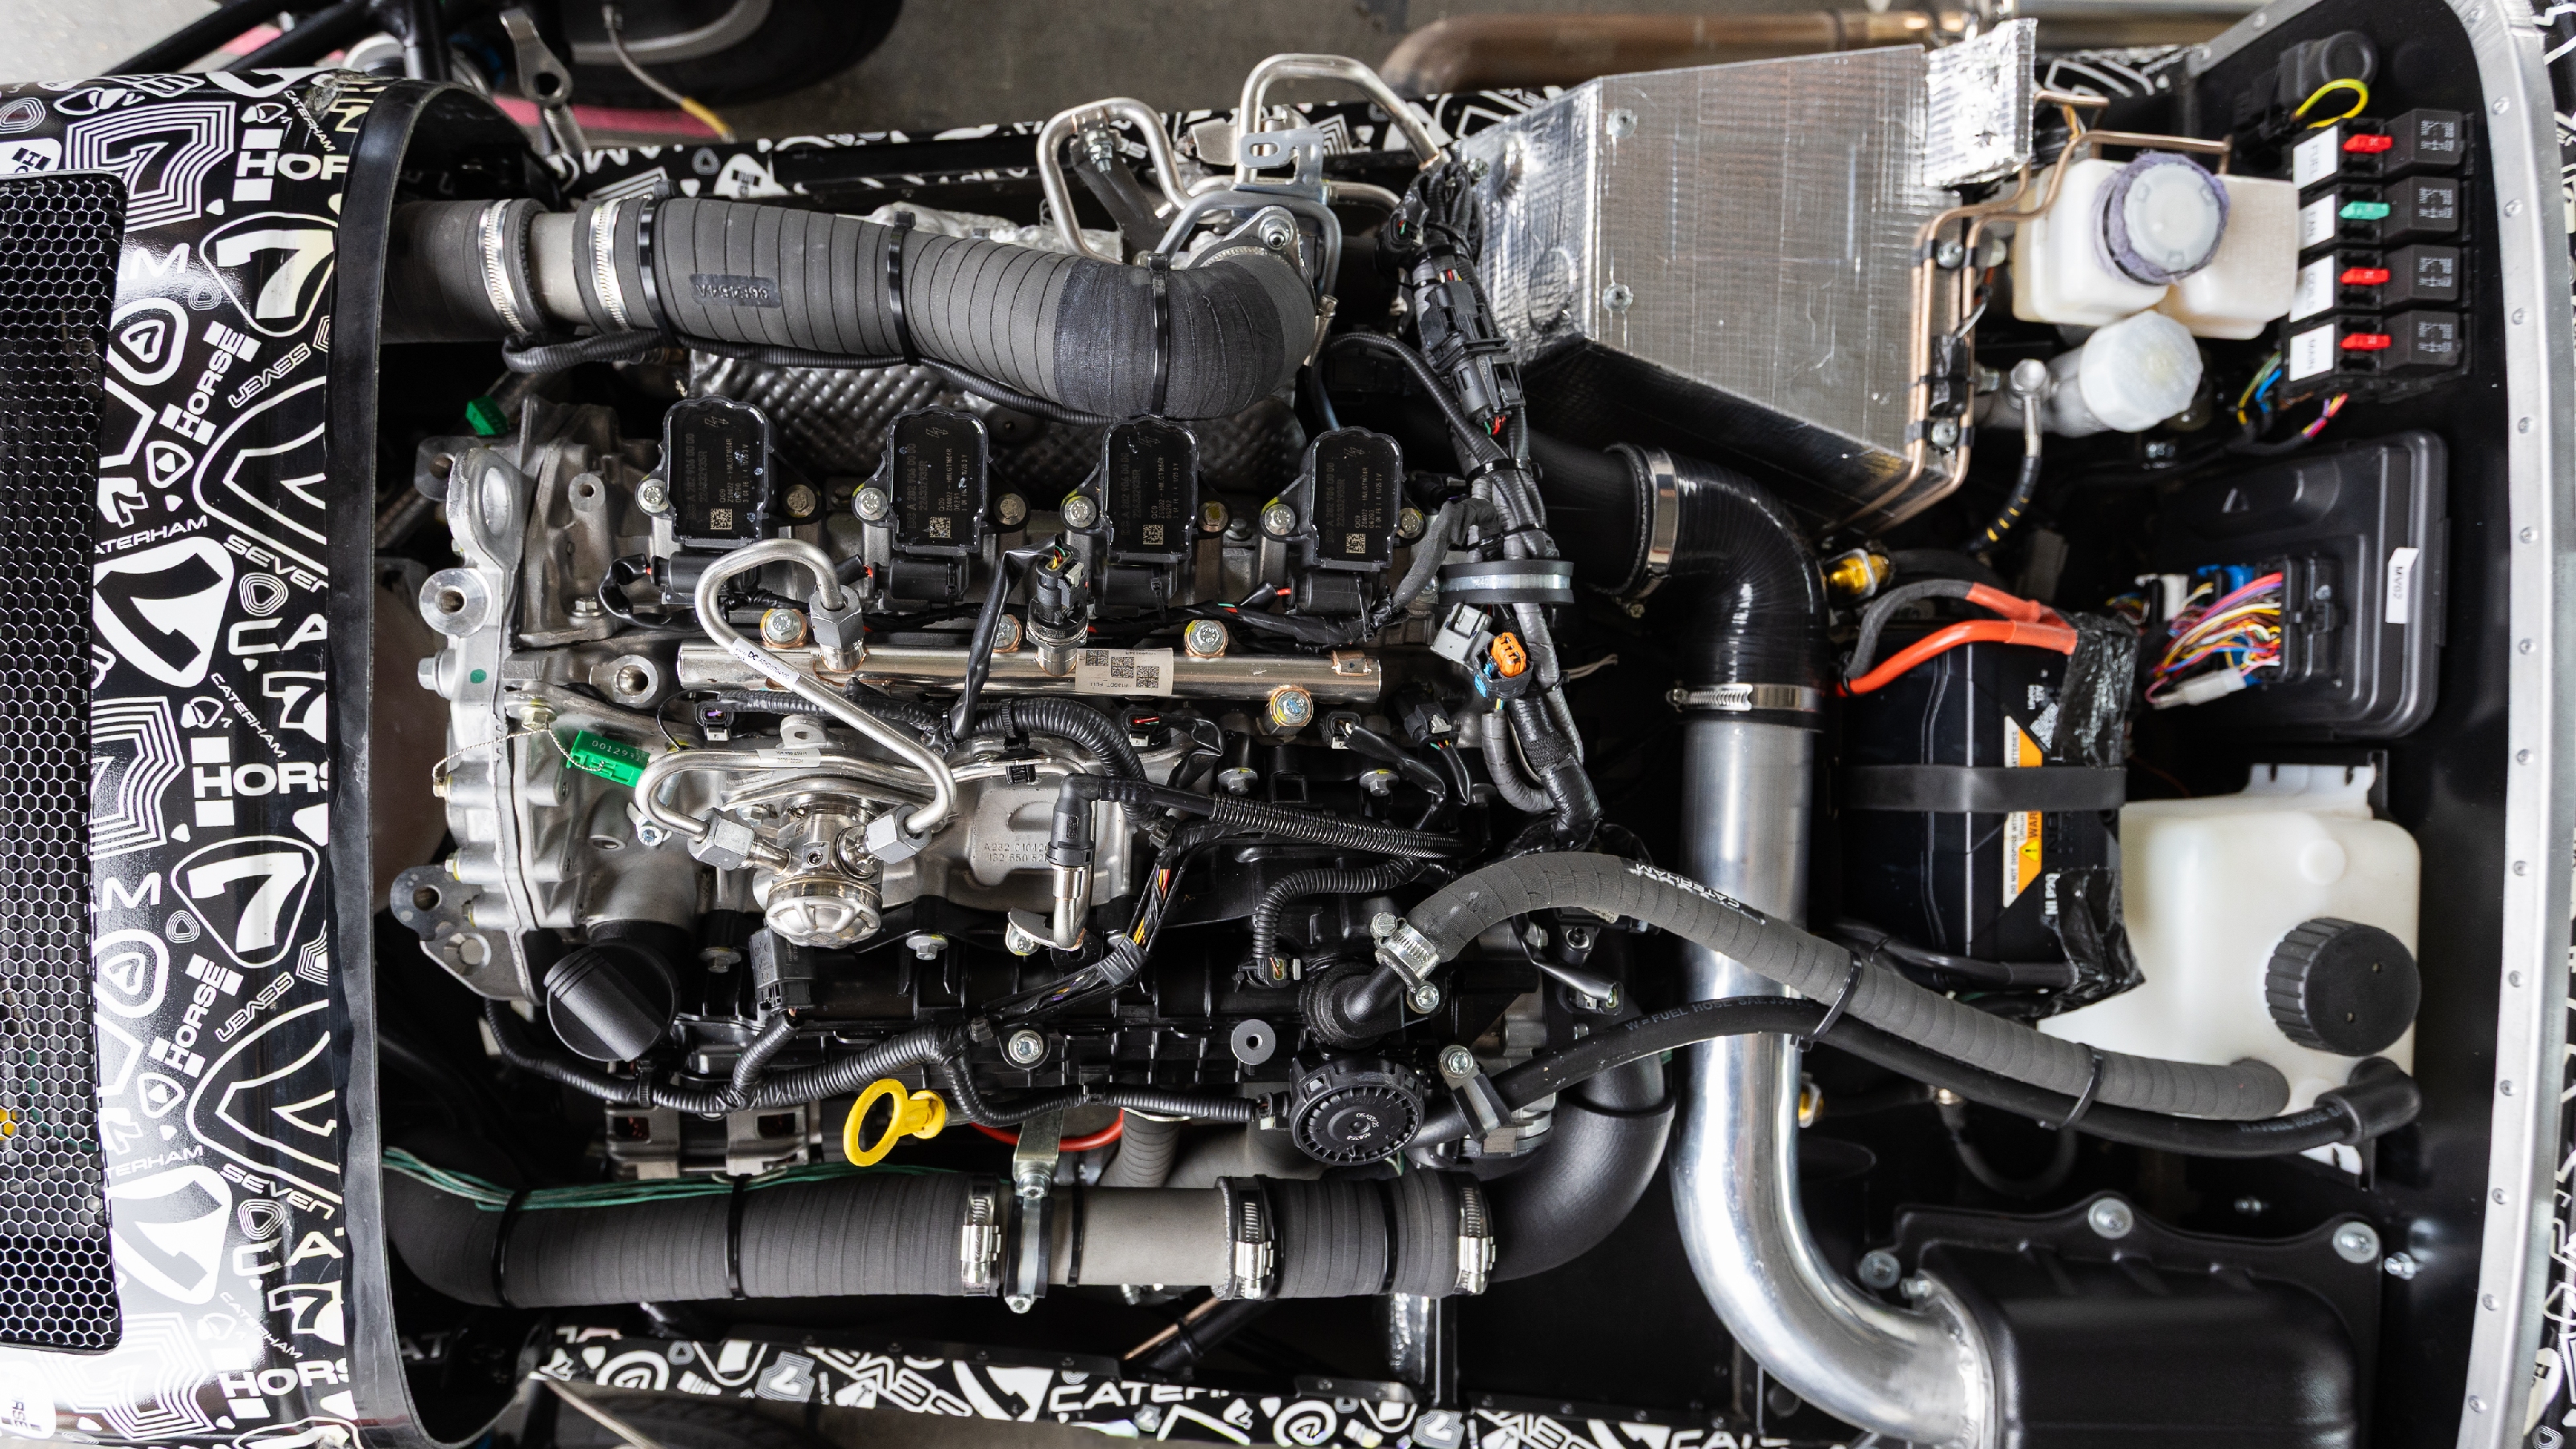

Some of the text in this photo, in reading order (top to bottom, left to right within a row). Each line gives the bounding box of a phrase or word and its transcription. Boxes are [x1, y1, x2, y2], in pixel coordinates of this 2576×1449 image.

[283, 89, 336, 152] CATERHAM
[174, 324, 245, 439] HORSE
[211, 673, 287, 758] CATERHAM
[187, 851, 307, 954] 7
[164, 960, 230, 1072] HORSE
